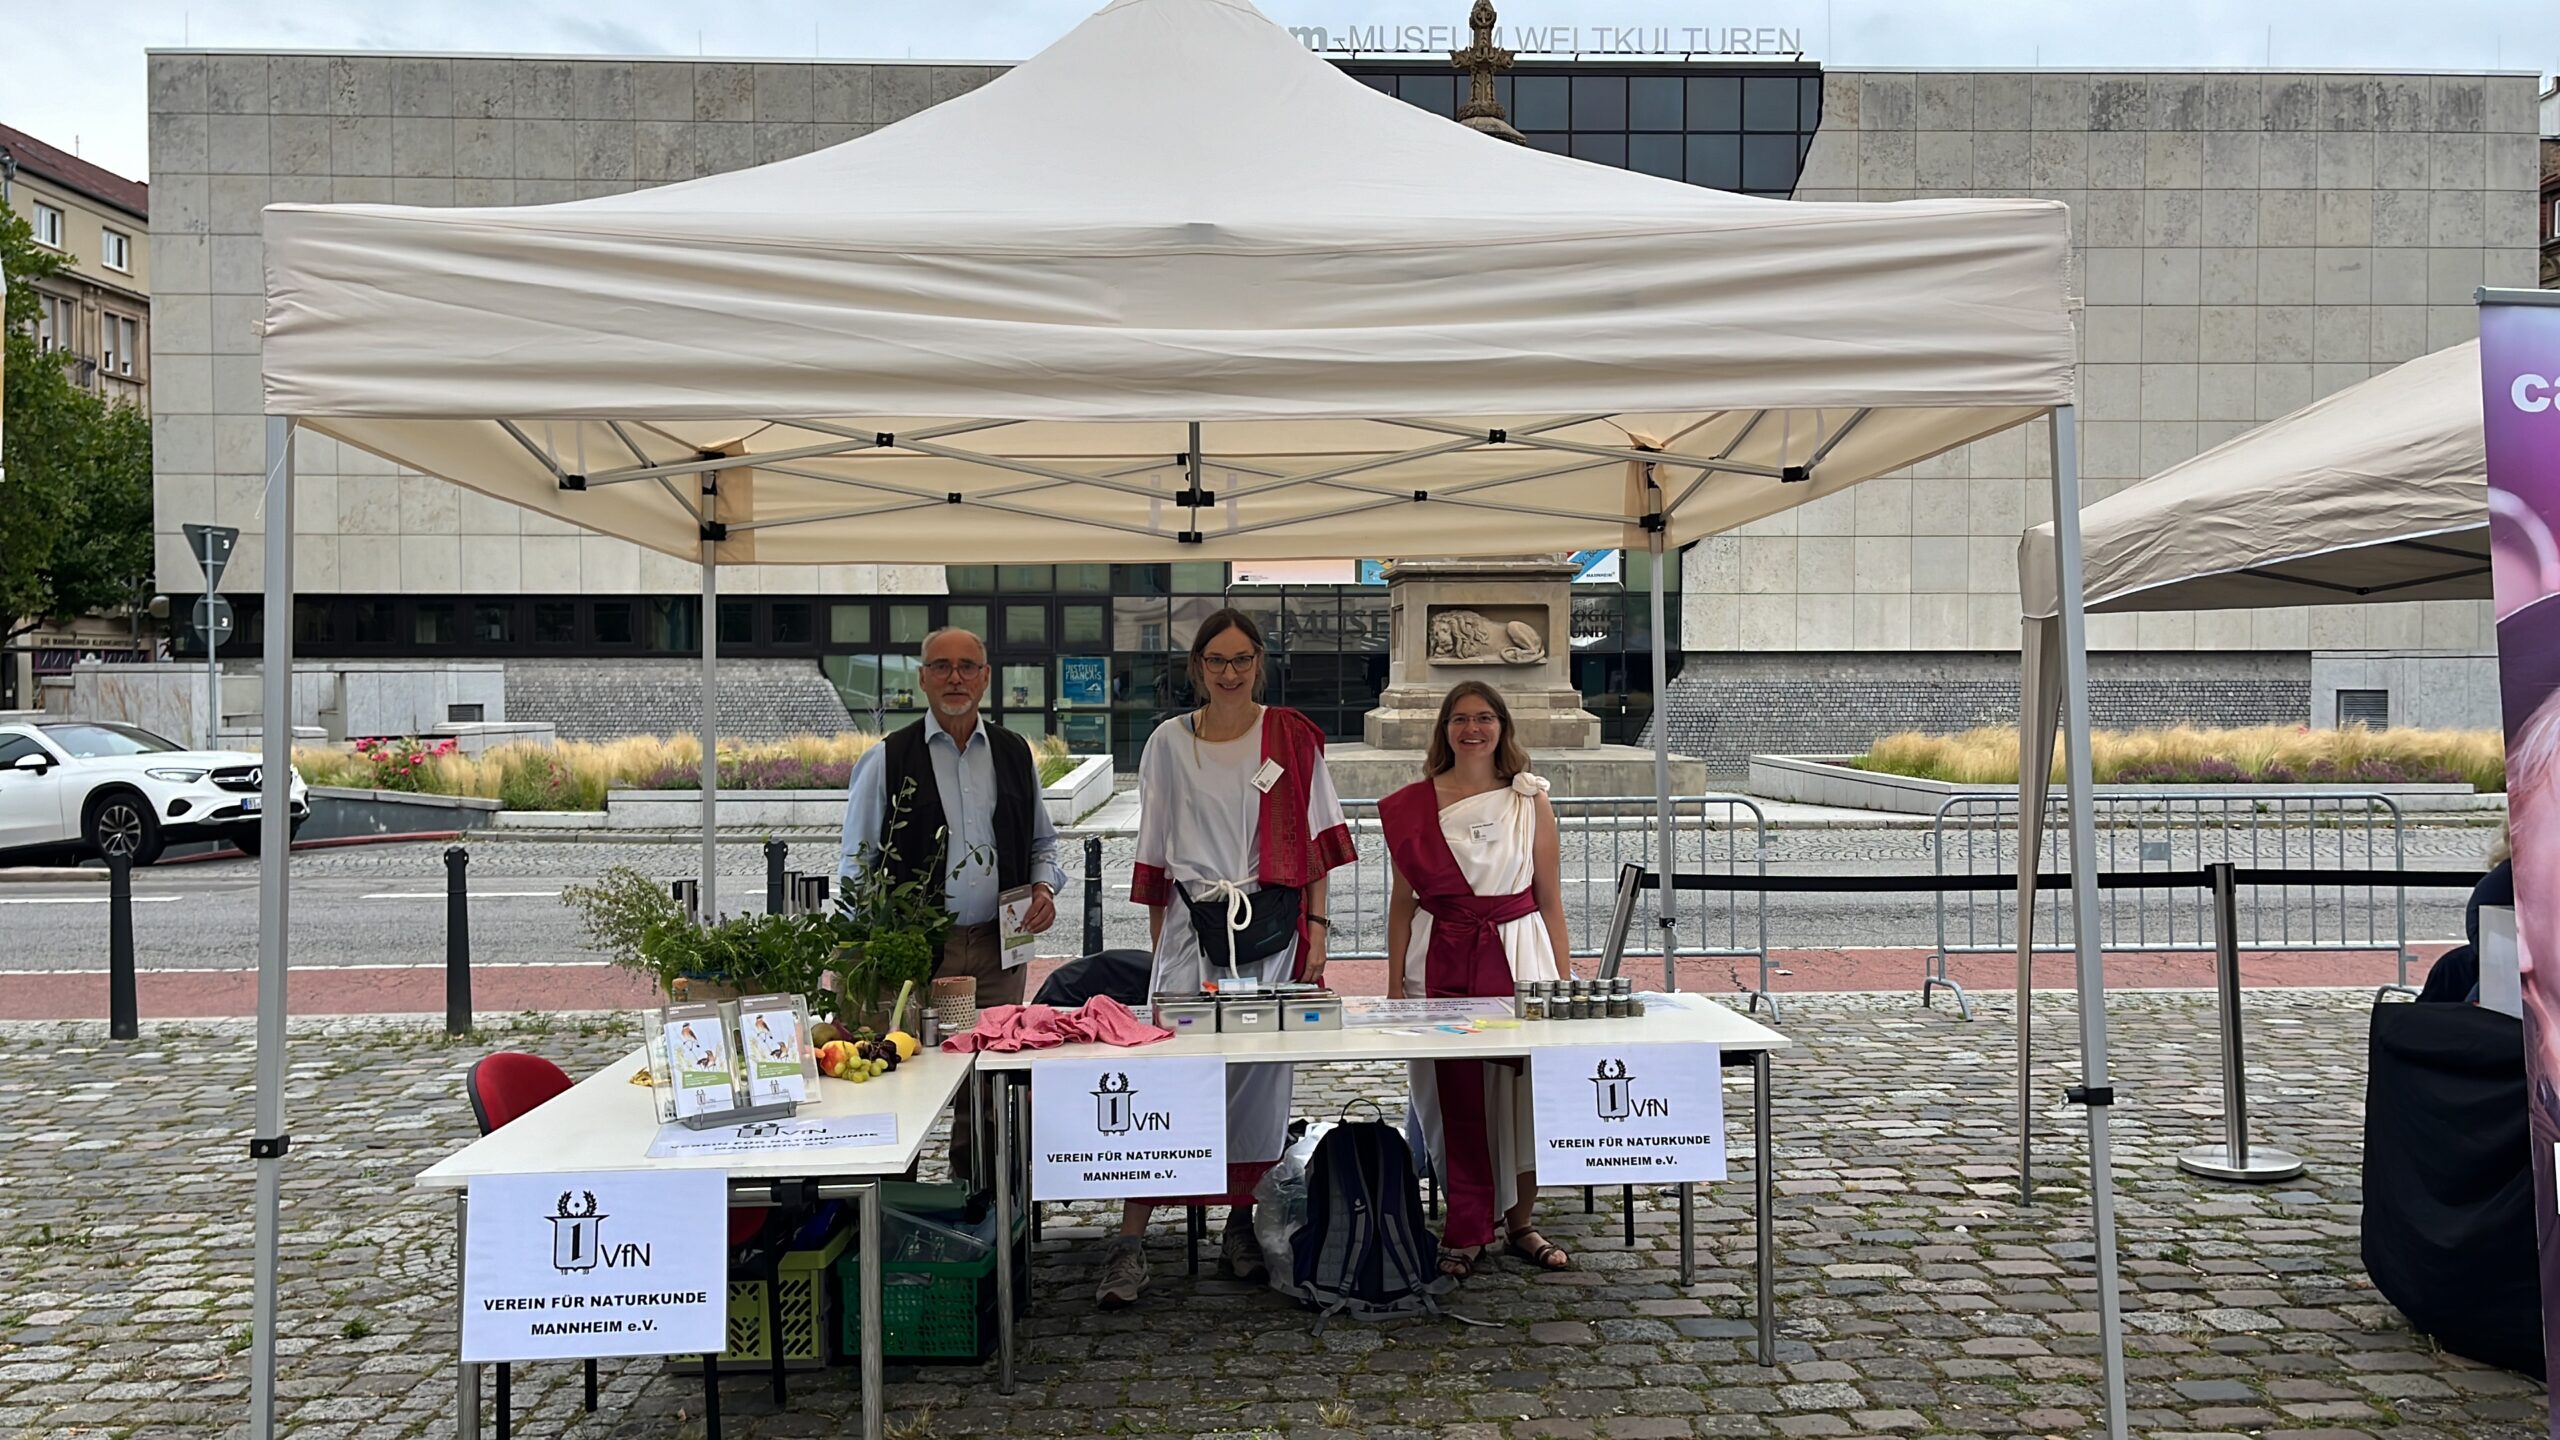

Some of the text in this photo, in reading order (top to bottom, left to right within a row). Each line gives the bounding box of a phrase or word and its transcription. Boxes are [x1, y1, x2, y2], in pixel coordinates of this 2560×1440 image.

[1514, 26, 1802, 53] WELTKULTUREN
[1631, 1098, 1669, 1117] VfN
[1132, 1111, 1170, 1131] VfN
[1549, 1135, 1711, 1149] VEREIN FÜR NATURKUNDE
[1046, 1148, 1213, 1163] VEREIN FÜR NATURKUNDE
[1585, 1155, 1678, 1167] MANNHEIM e.V.
[1083, 1169, 1177, 1182] MANNHEIM e.V.
[600, 1242, 651, 1268] VfN
[483, 1291, 707, 1311] VEREIN FÜR NATURKUNDE
[531, 1319, 658, 1336] MANNHEIM e.V.
